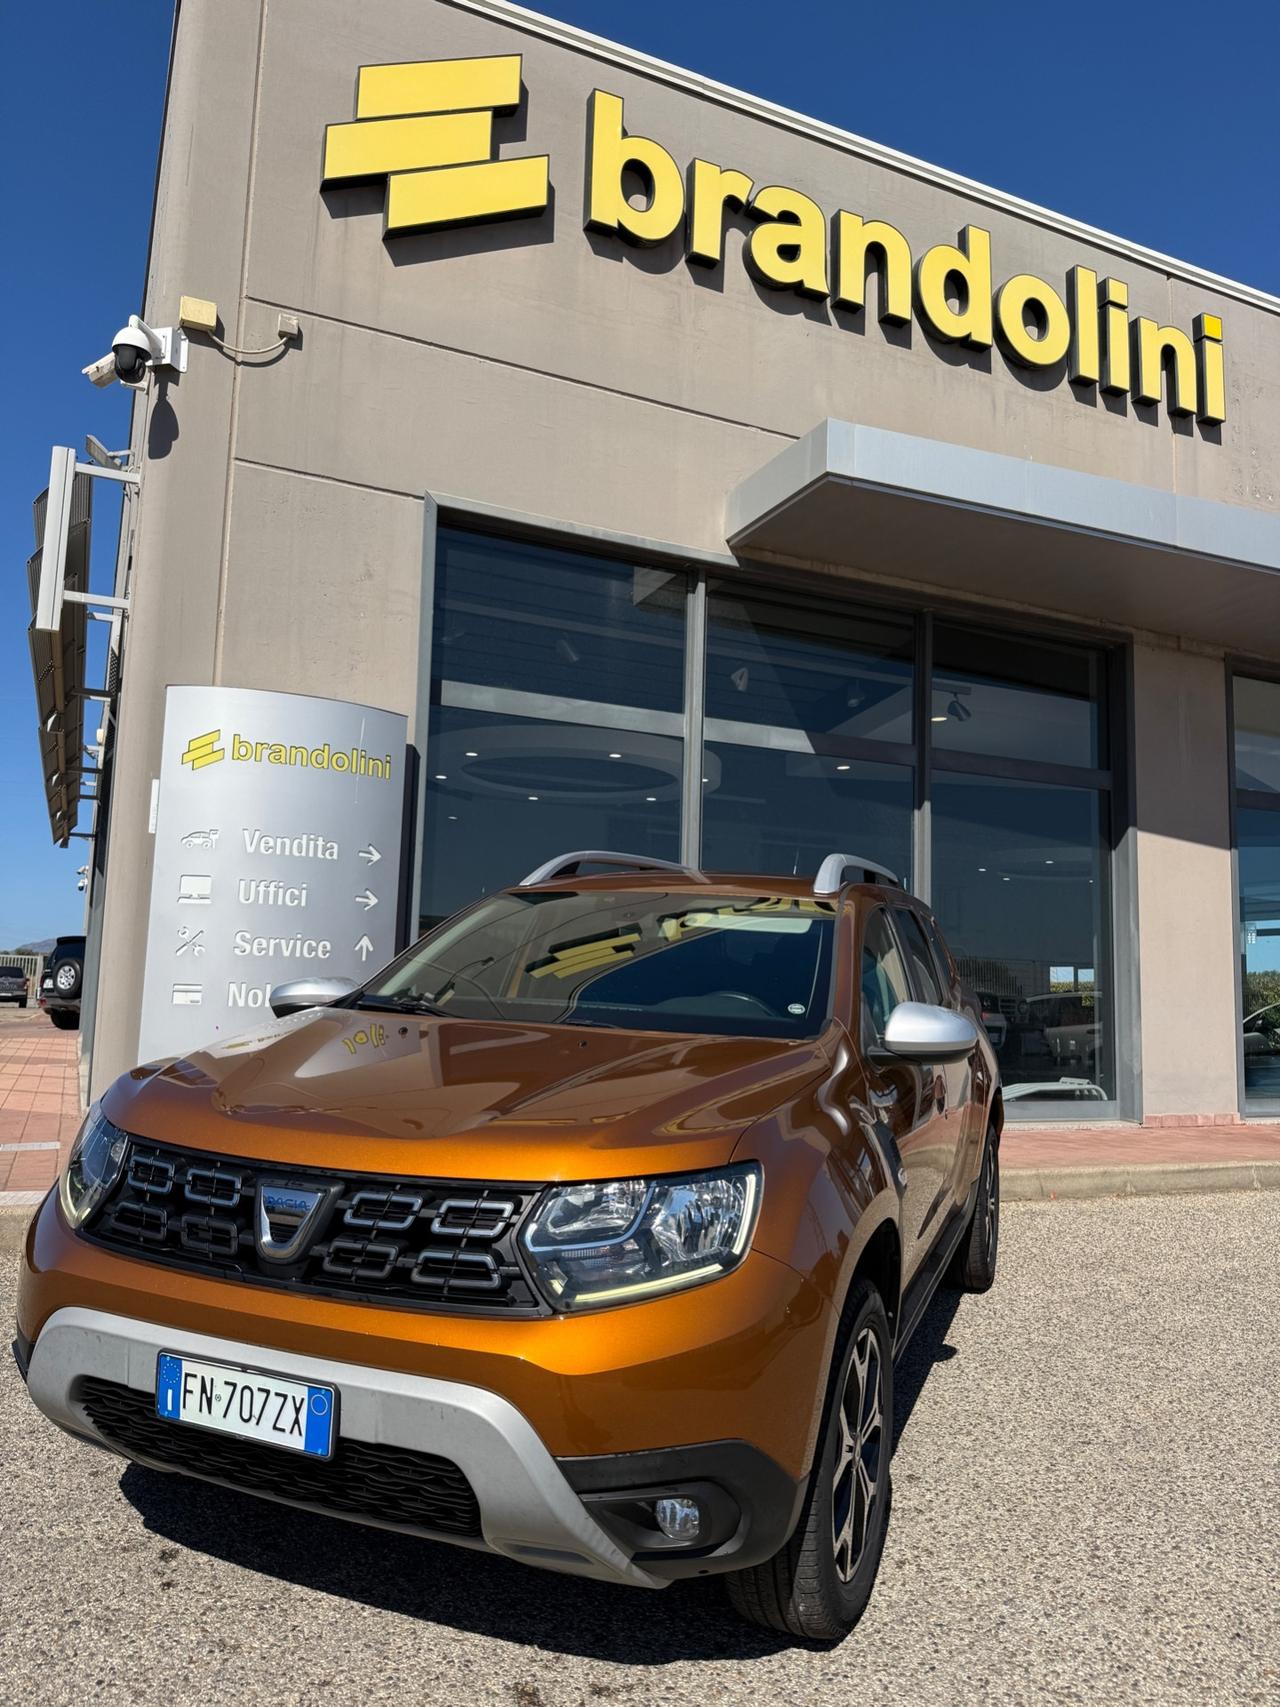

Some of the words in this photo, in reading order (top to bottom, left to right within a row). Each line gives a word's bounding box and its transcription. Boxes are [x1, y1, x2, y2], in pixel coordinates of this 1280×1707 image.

[584, 88, 1226, 425] brandolini
[231, 734, 392, 780] brandolini
[243, 828, 338, 860] Vendita
[239, 879, 308, 907] Uffici
[233, 930, 331, 959] Service
[228, 982, 271, 1008] Nol
[267, 1196, 310, 1211] DACIA
